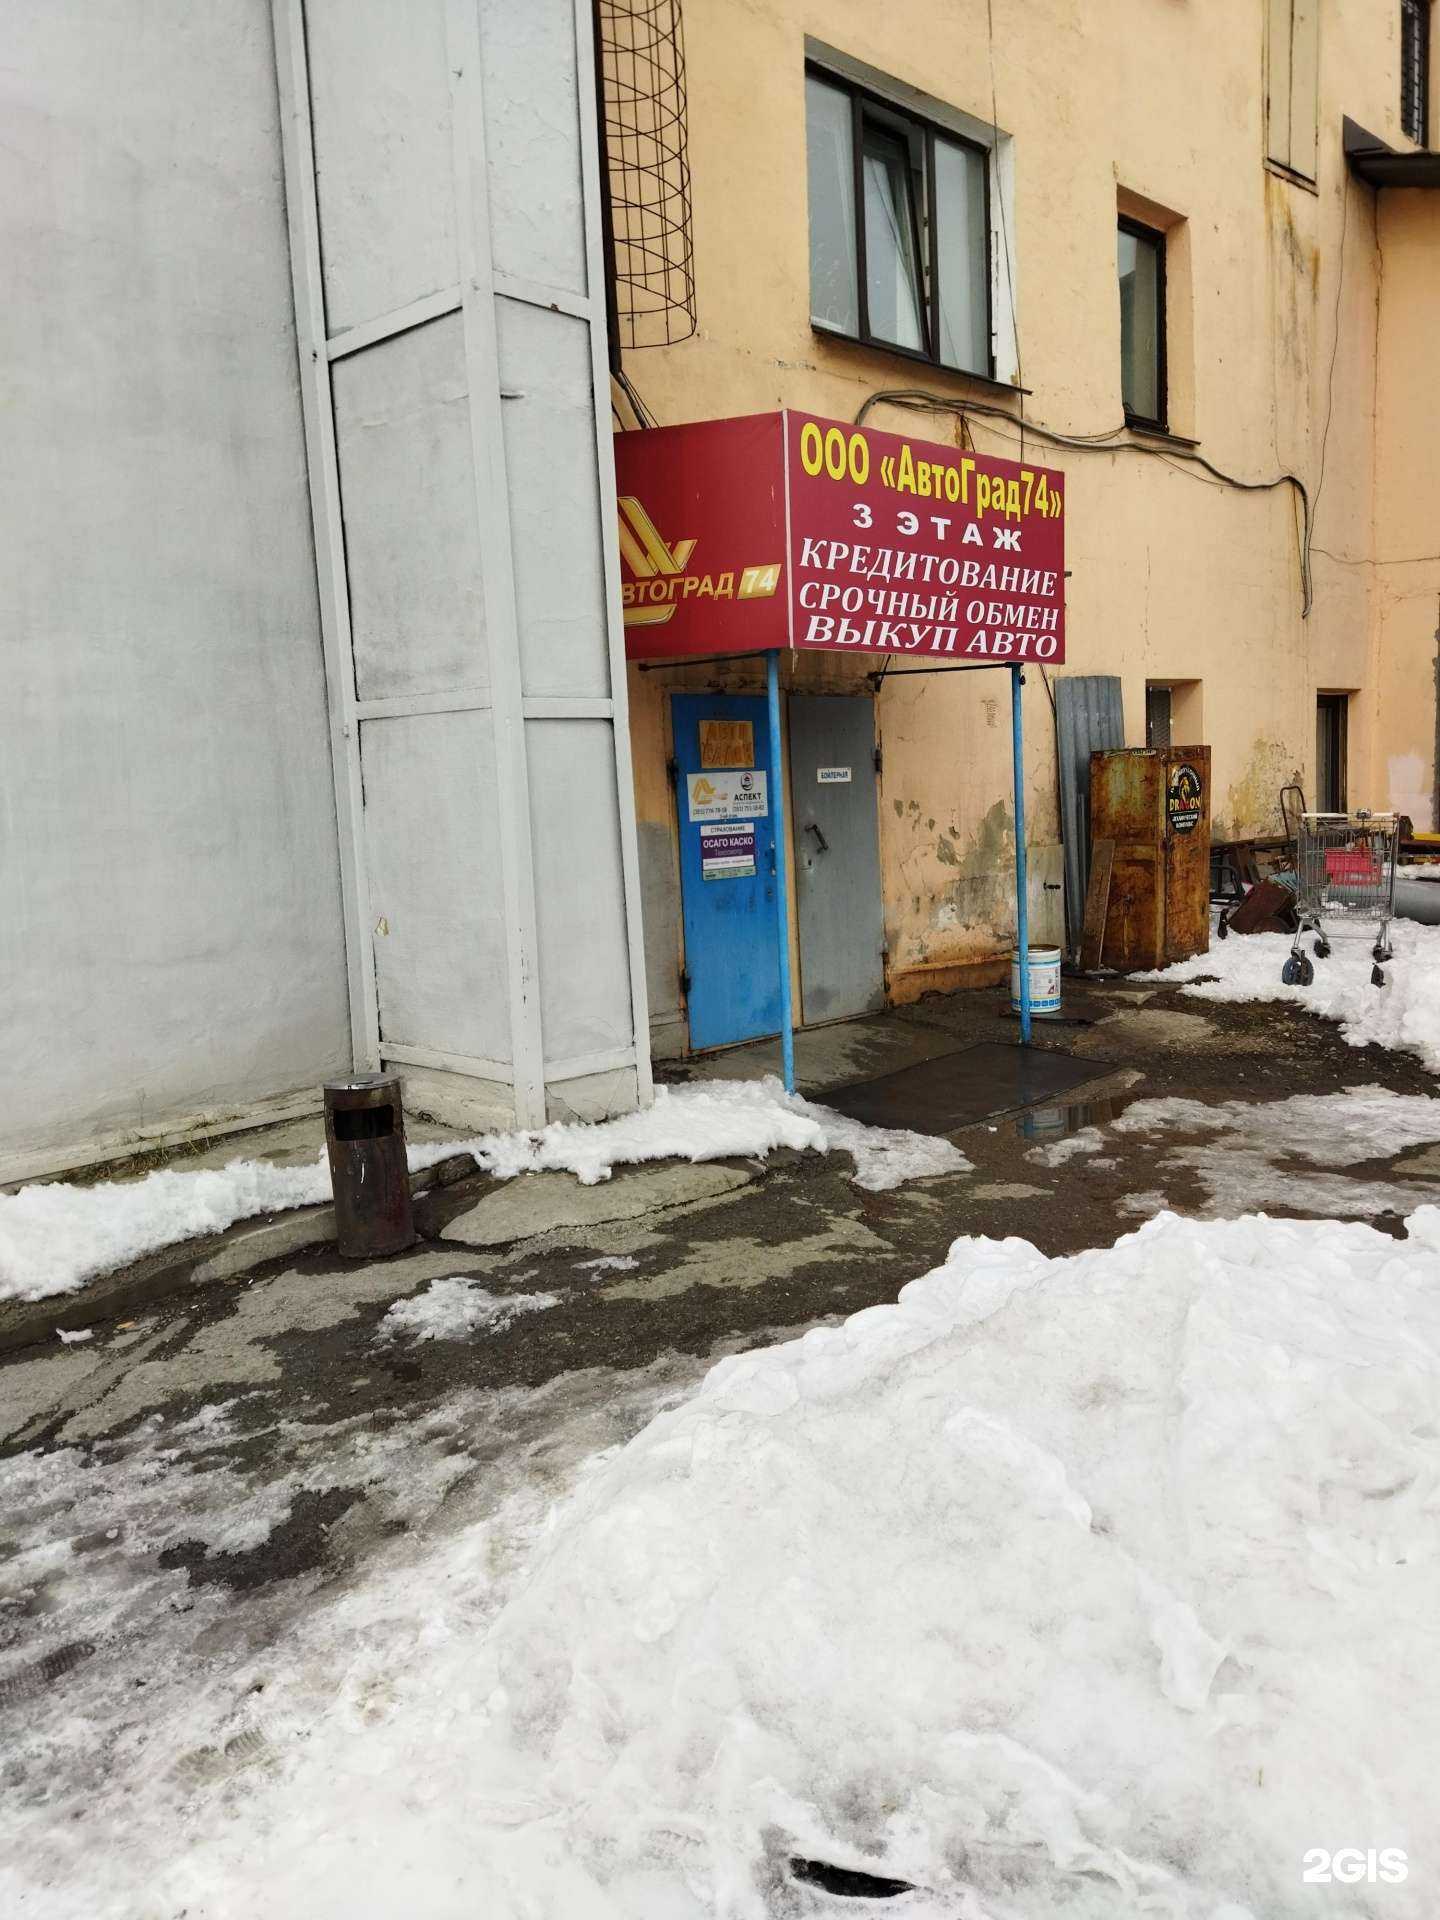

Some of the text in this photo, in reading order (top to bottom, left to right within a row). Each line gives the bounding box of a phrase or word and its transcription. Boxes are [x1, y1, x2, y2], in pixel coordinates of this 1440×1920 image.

[800, 422, 1062, 522] ООО «АвтоГрад74»
[852, 503, 1022, 552] 3 ЭТАЖ
[622, 567, 774, 604] ВТОГРАД 74
[800, 537, 1058, 597] КРЕДИТОВАНИЕ
[799, 582, 1057, 631] СРОЧНЫЙ ОБМЕН
[804, 615, 1058, 658] ВЫКУП АВТО
[703, 836, 753, 849] ОСАГО КАСКО
